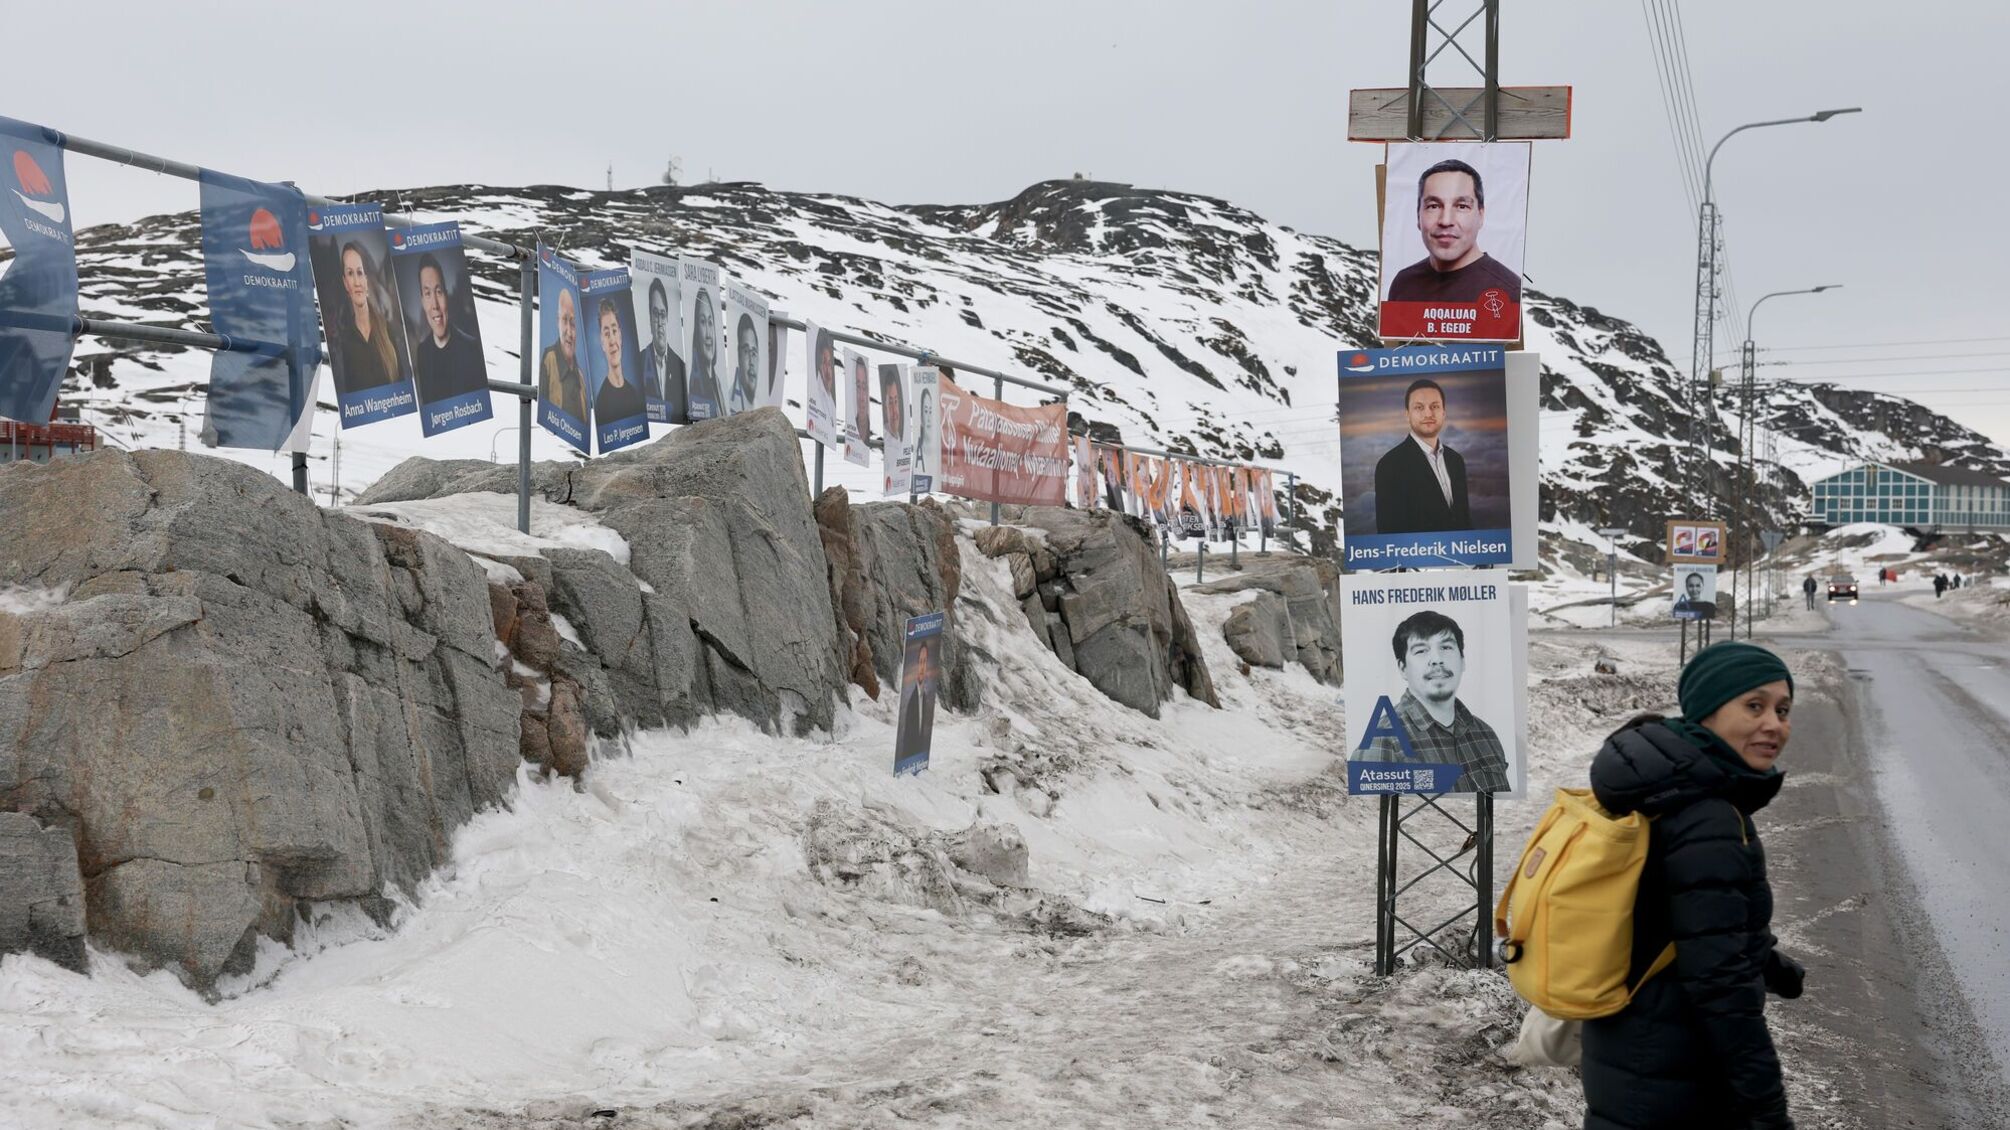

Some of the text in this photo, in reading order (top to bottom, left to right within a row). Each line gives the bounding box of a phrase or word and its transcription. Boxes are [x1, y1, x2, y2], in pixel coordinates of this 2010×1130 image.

[323, 211, 380, 227] DEMOKRAATIT
[406, 229, 458, 247] DEMOKRAATIT
[243, 275, 298, 289] DEMOKRAATIT
[591, 274, 629, 289] DEMOKRAATIT
[1423, 308, 1477, 320] AQQALUAQ
[1427, 322, 1472, 333] B. EGEDE
[1379, 350, 1498, 369] DEMOKRAATIT
[344, 391, 412, 418] Anna Wangenheim
[430, 399, 483, 428] Jørgen Rosbach
[561, 418, 582, 441] Ottosen
[603, 433, 614, 445] Leo
[619, 424, 644, 442] Jørgensen
[1349, 540, 1507, 562] Jens-Frederik Nielsen
[1352, 585, 1497, 605] HANS FREDERIK MØLLER
[1358, 695, 1418, 759] A
[1360, 769, 1411, 782] Atassut
[1395, 782, 1411, 790] 2025
